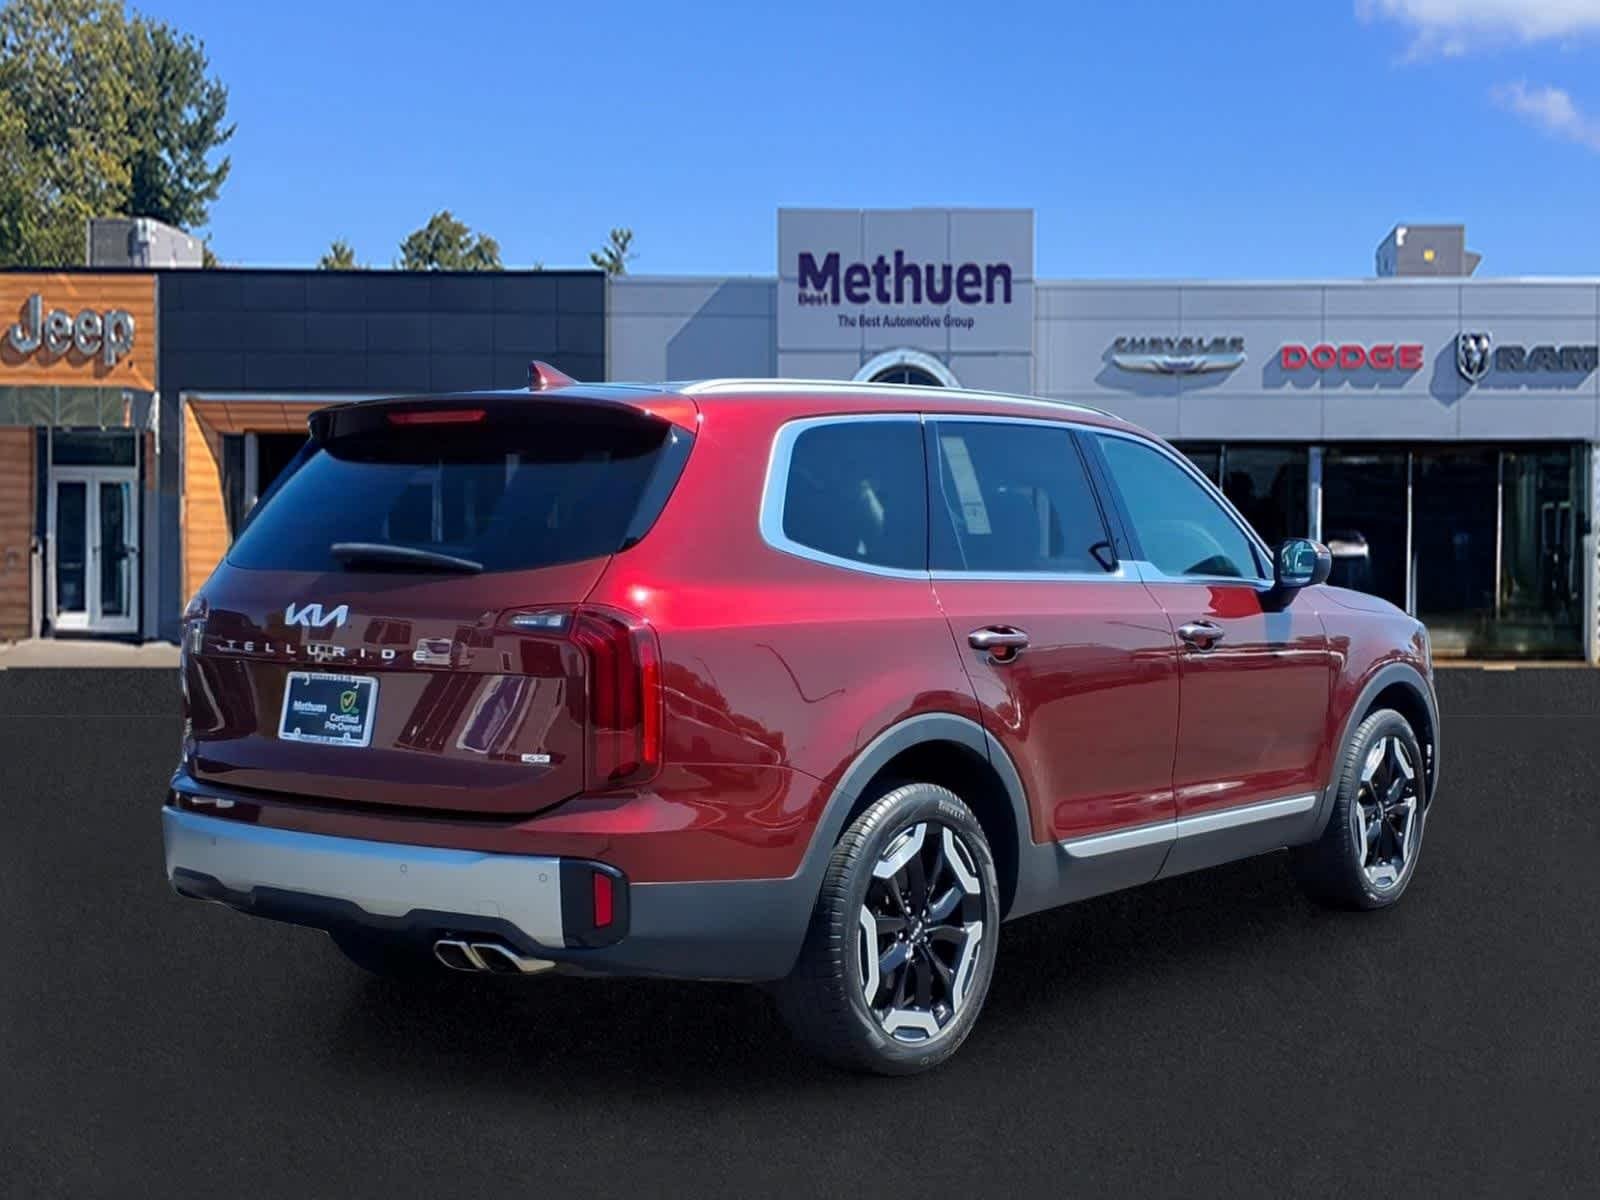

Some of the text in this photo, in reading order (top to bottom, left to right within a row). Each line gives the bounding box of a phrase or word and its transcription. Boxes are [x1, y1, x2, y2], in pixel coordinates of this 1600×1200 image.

[798, 249, 1012, 304] Methuen
[10, 293, 135, 366] Jeep
[838, 314, 974, 330] The Best Automotive Group
[1113, 336, 1244, 352] CHRYSLER
[1281, 344, 1424, 370] DODGE
[1495, 345, 1598, 371] RAM
[284, 602, 348, 627] KIA
[227, 639, 428, 661] TELLURIDE
